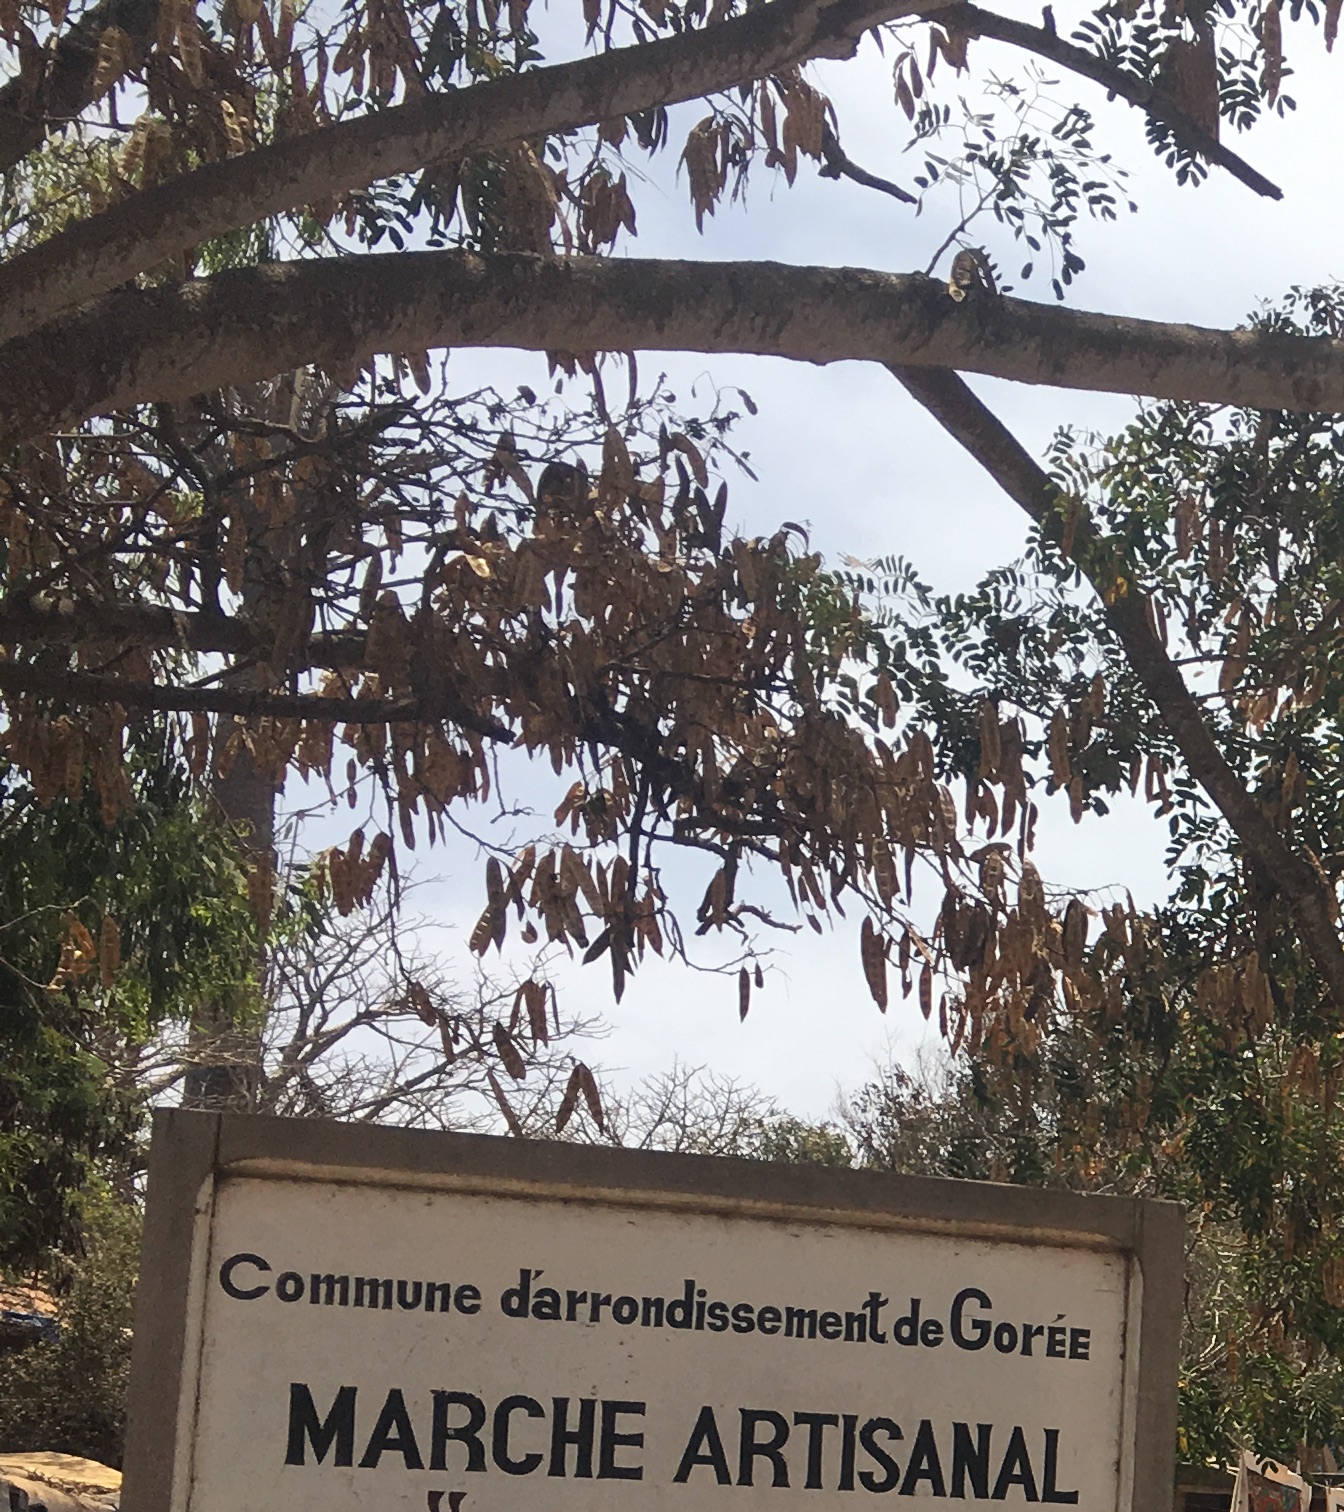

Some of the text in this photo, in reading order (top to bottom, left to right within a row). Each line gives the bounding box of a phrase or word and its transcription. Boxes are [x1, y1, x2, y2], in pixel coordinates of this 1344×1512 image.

[218, 1252, 483, 1315] Commune
[893, 1297, 945, 1349] de
[283, 1382, 1080, 1505] MARCHE ARTISANAL
